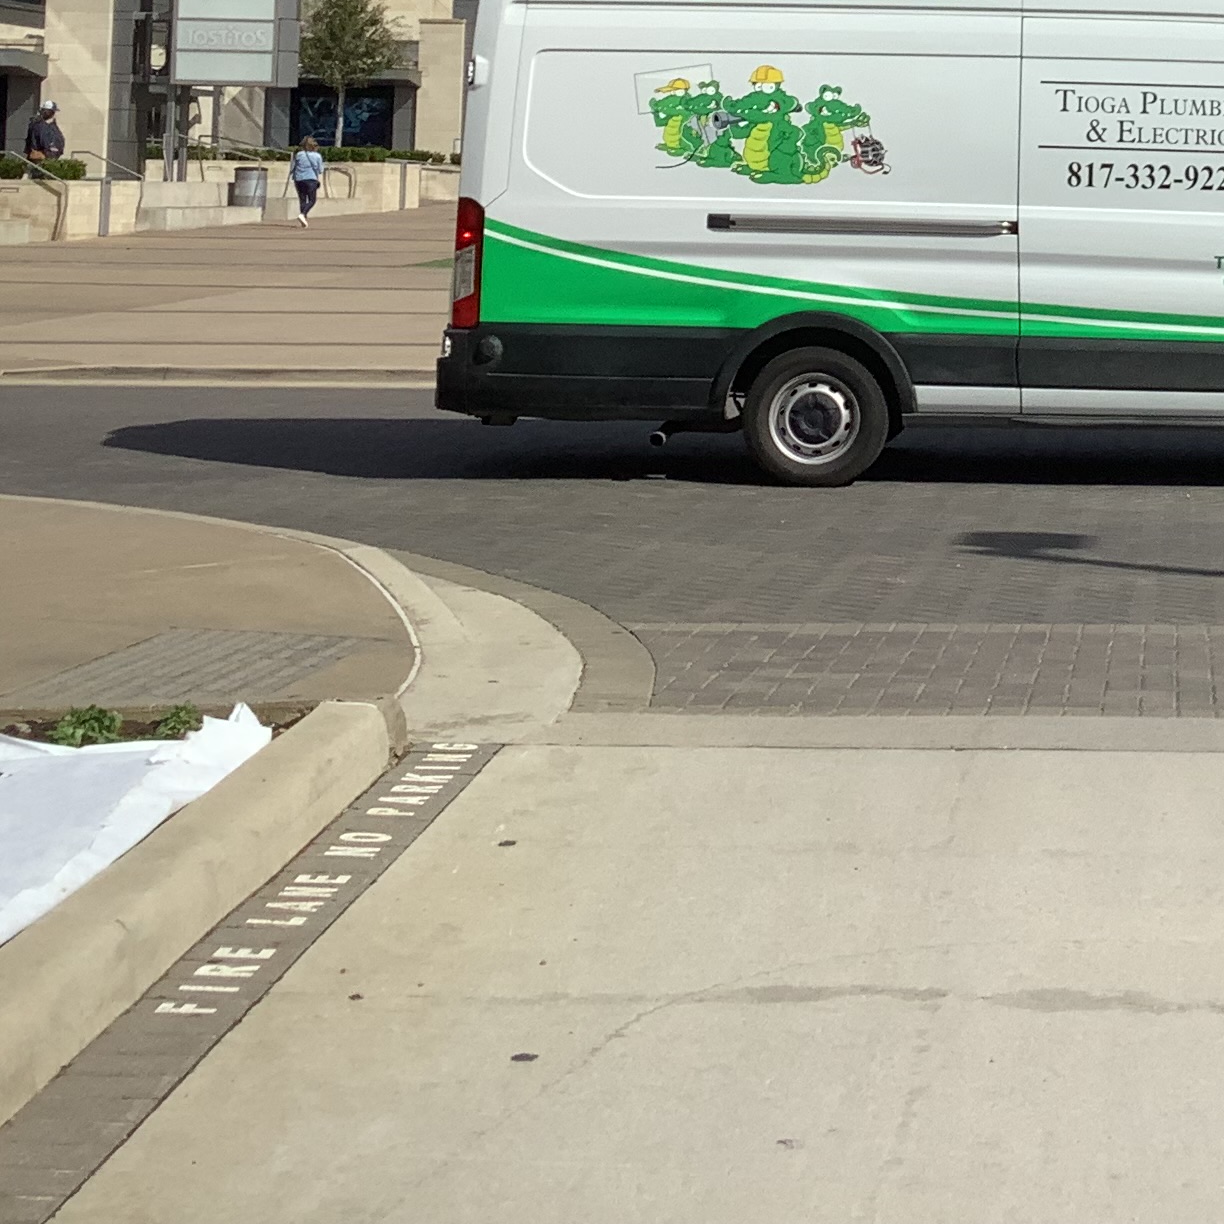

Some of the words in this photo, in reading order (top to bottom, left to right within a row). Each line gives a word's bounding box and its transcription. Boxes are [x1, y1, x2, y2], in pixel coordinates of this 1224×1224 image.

[1085, 119, 1107, 143] &
[154, 946, 276, 1014] FIRE
[245, 873, 352, 926] LANE
[324, 832, 393, 857] NO
[366, 742, 479, 817] PARKING
